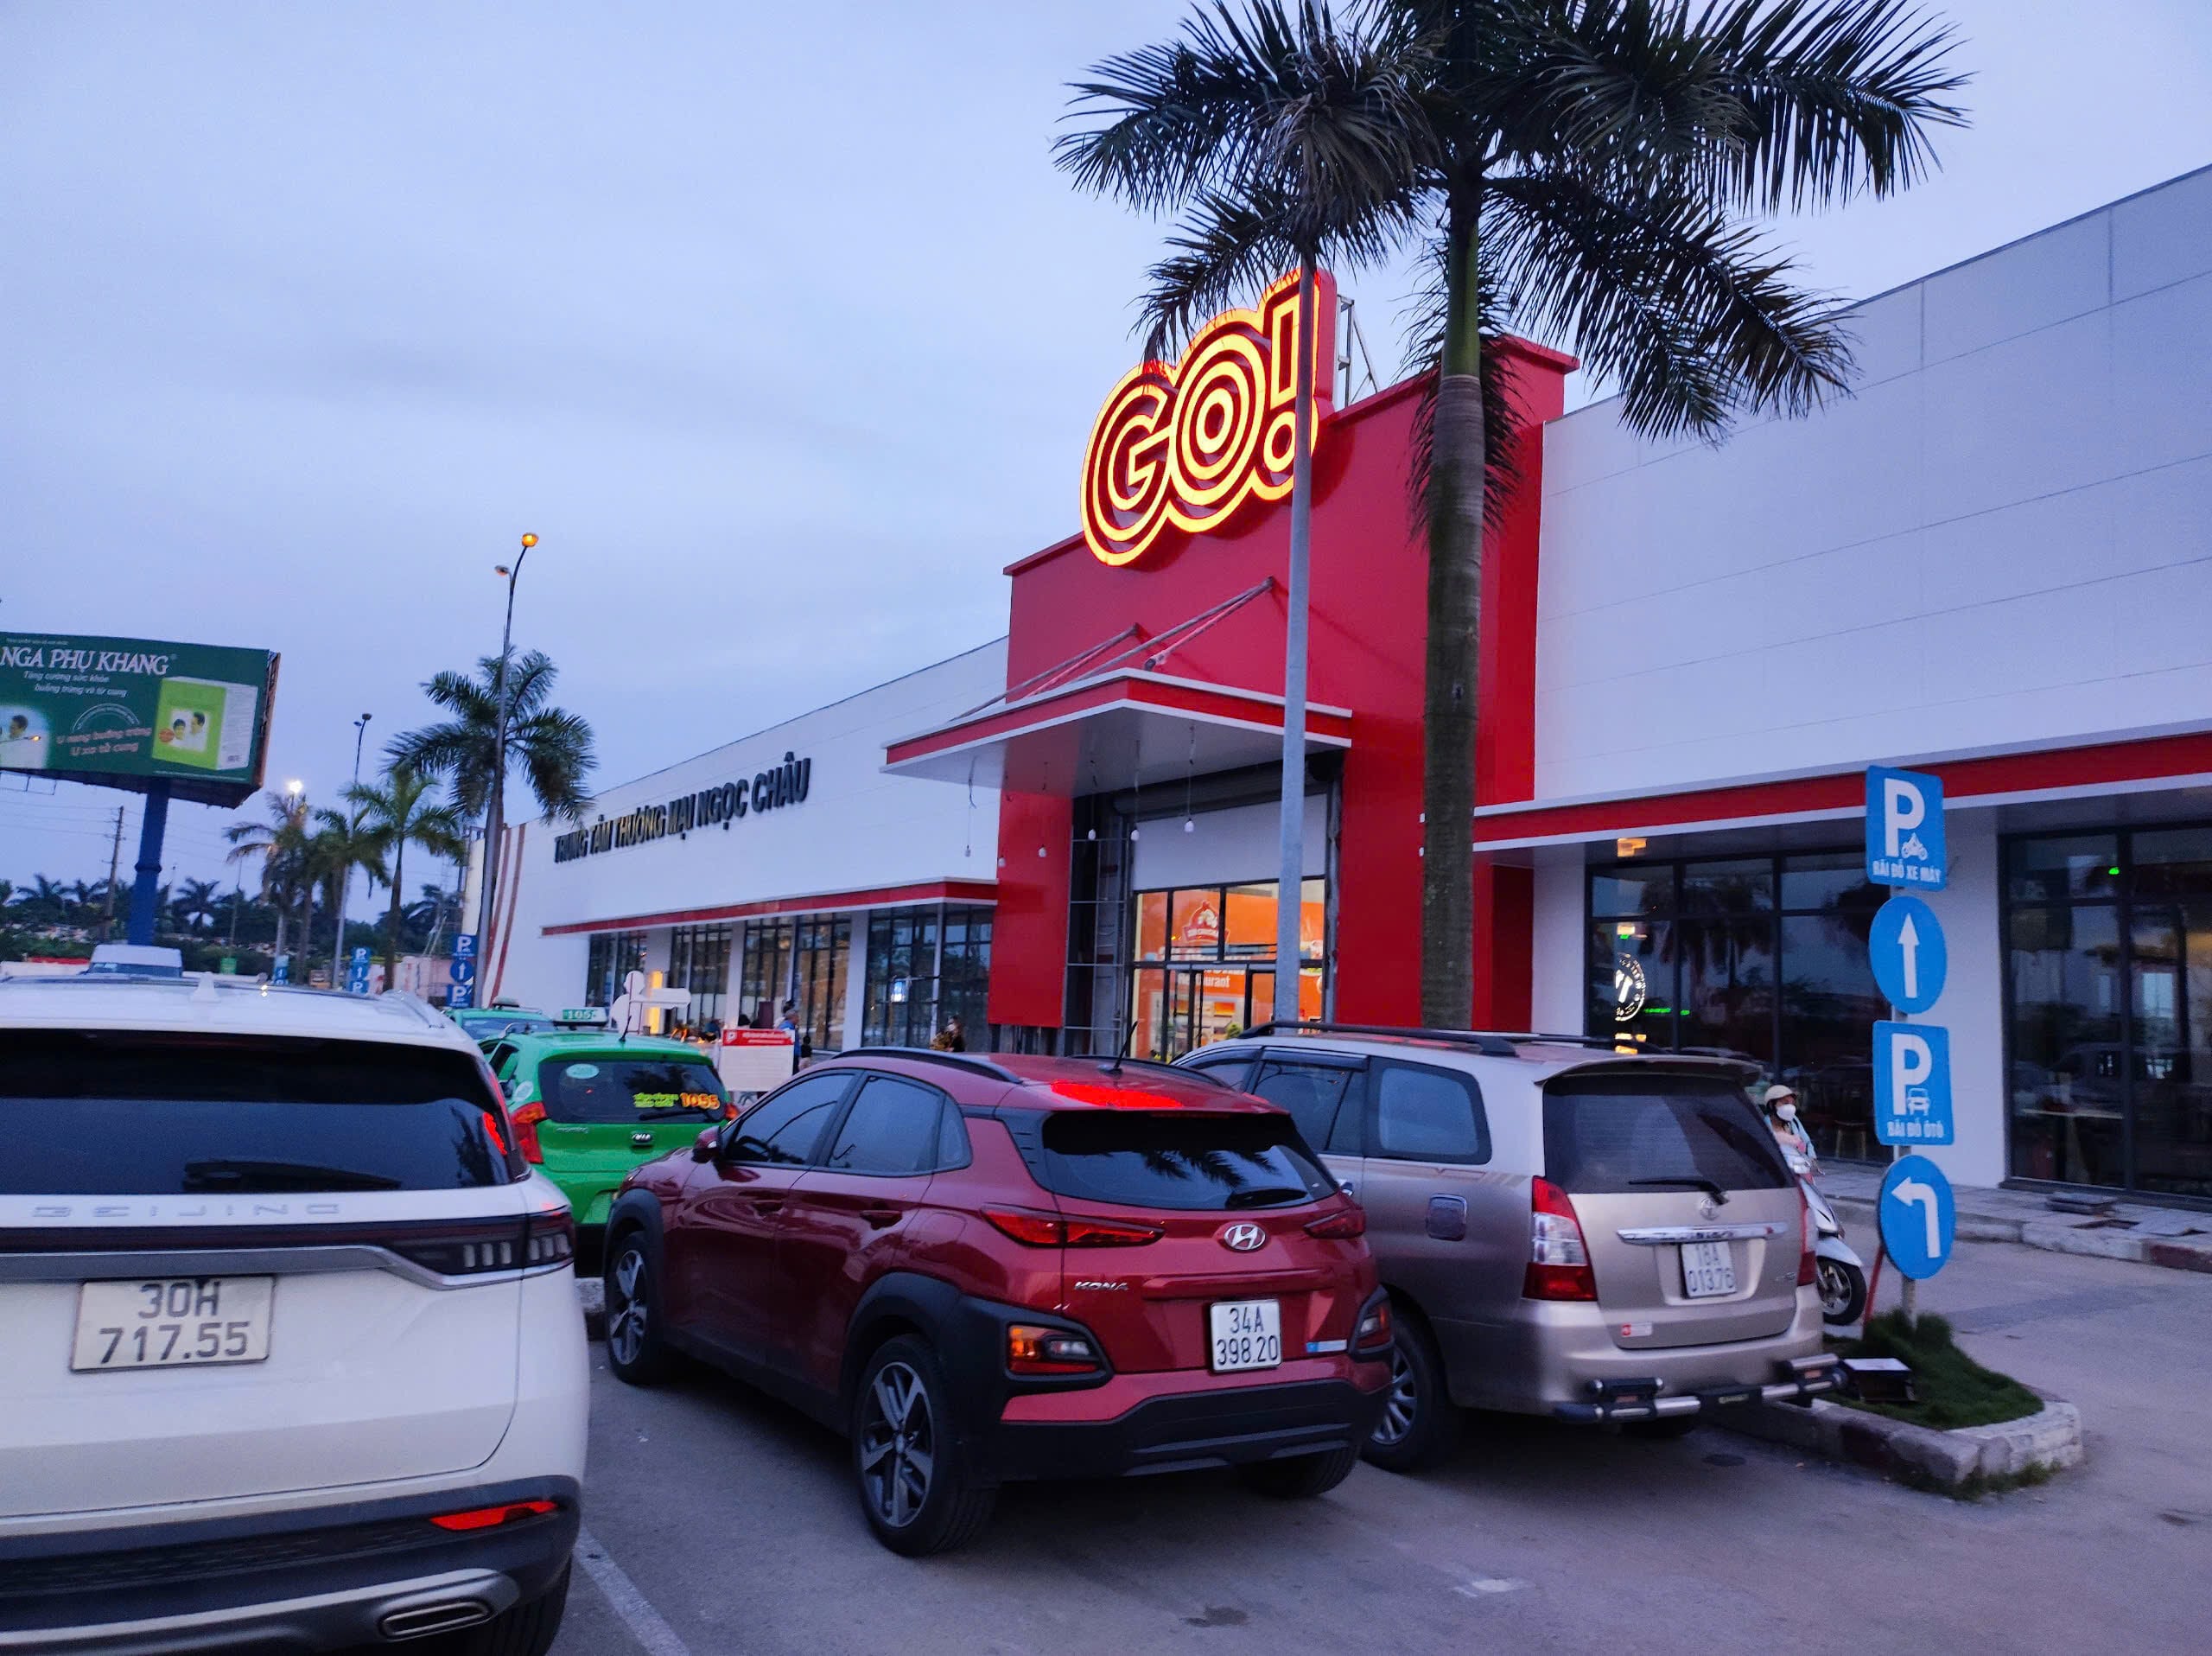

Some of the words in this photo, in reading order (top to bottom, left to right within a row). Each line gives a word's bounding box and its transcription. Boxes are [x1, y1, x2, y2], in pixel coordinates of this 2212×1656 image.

[1080, 267, 1320, 567] GO!
[0, 646, 44, 668] NGA
[48, 648, 96, 673] PHỤ
[95, 651, 169, 676] KHANG
[667, 793, 696, 840] MẠI
[696, 779, 749, 831] NGỌC
[752, 751, 810, 813] CHÂU
[1884, 777, 1926, 858] P
[1906, 864, 1919, 881] XE
[456, 936, 472, 952] P
[452, 986, 467, 1003] P
[1891, 1033, 1932, 1116] P
[32, 1203, 340, 1218] BEIJING
[137, 1280, 221, 1319] 30H
[1074, 1281, 1128, 1291] KONA
[1230, 1306, 1264, 1334] 34A
[99, 1321, 251, 1364] 717.55
[1217, 1335, 1279, 1366] 398.20
